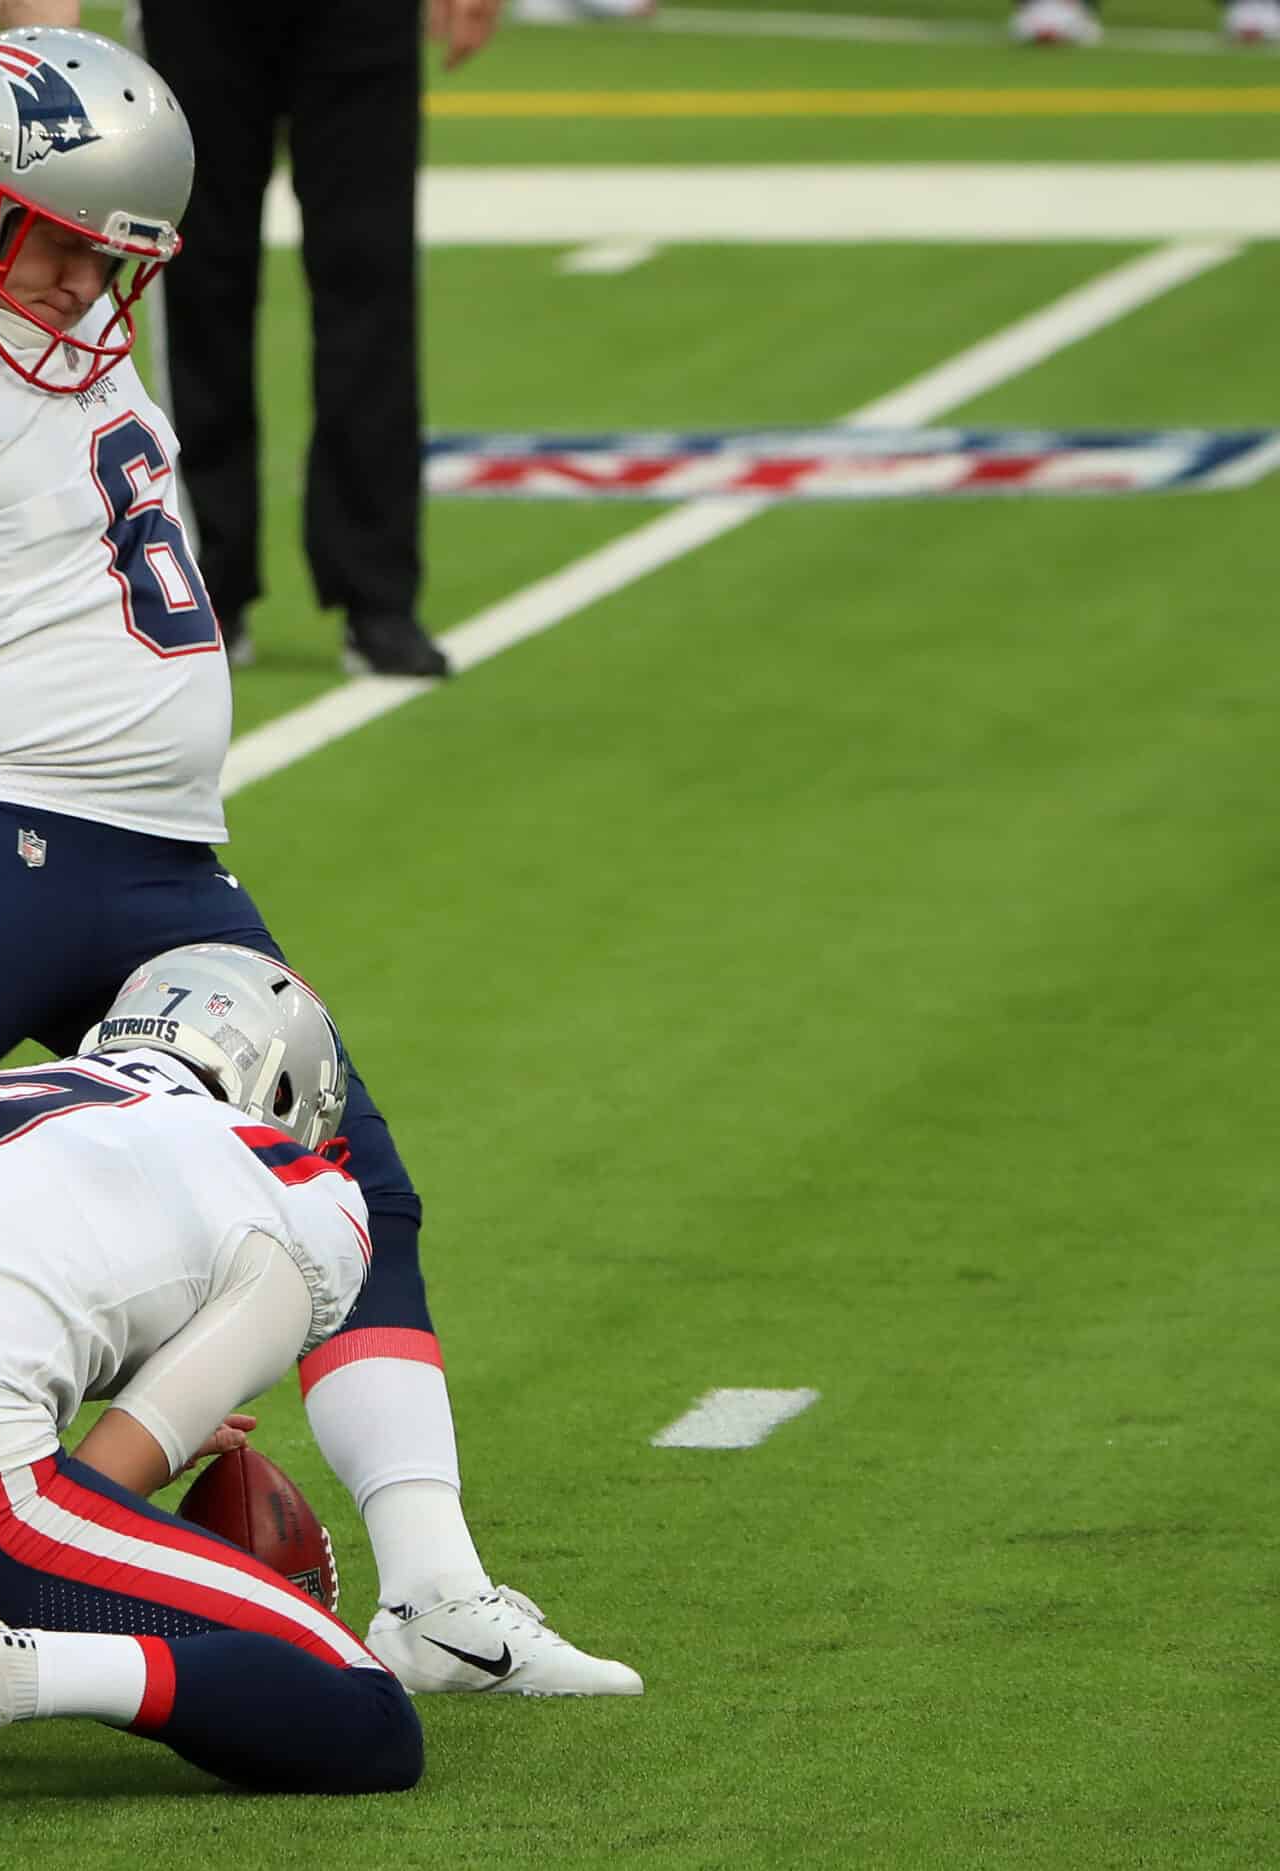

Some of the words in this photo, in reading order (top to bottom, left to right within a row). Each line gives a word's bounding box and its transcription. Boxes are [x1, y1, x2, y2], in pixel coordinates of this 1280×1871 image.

[90, 409, 221, 658] 6
[159, 987, 193, 1017] 7
[97, 1017, 181, 1044] PATRIOTS
